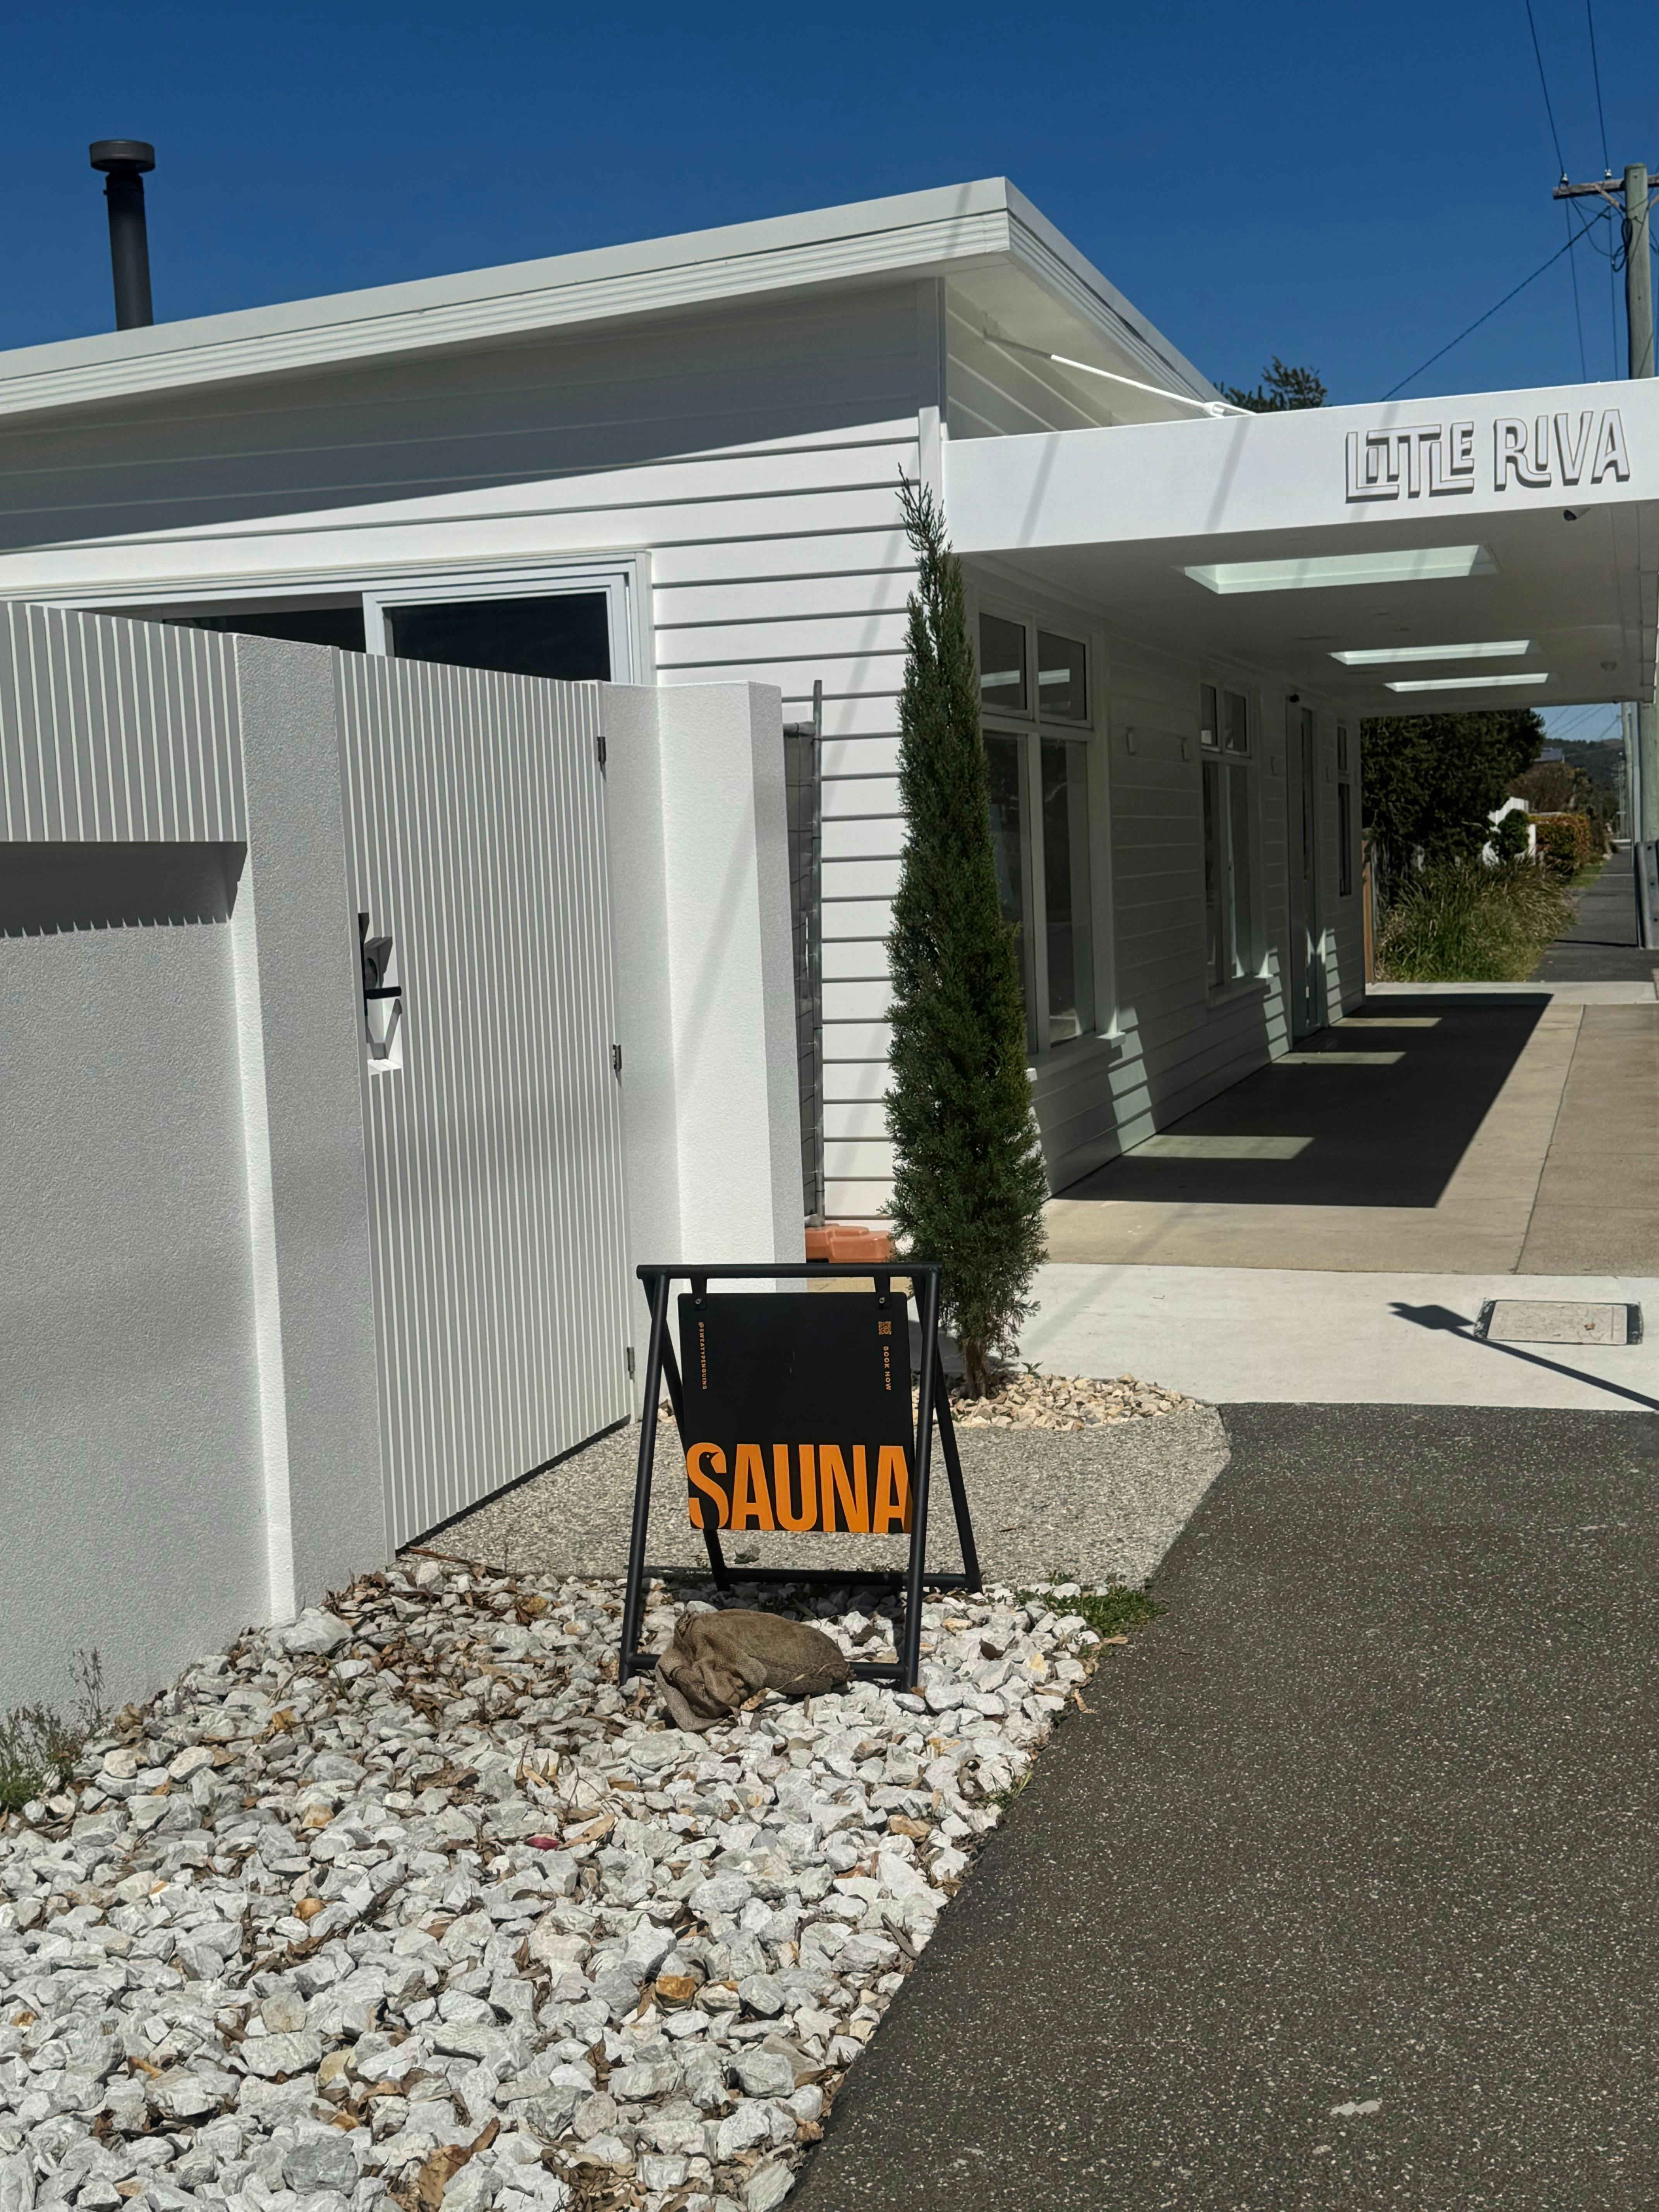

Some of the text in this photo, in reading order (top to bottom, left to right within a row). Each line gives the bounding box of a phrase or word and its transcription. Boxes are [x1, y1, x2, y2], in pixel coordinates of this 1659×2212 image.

[1346, 409, 1630, 503] LITTLE RIVA
[687, 1442, 913, 1534] SAUNA
